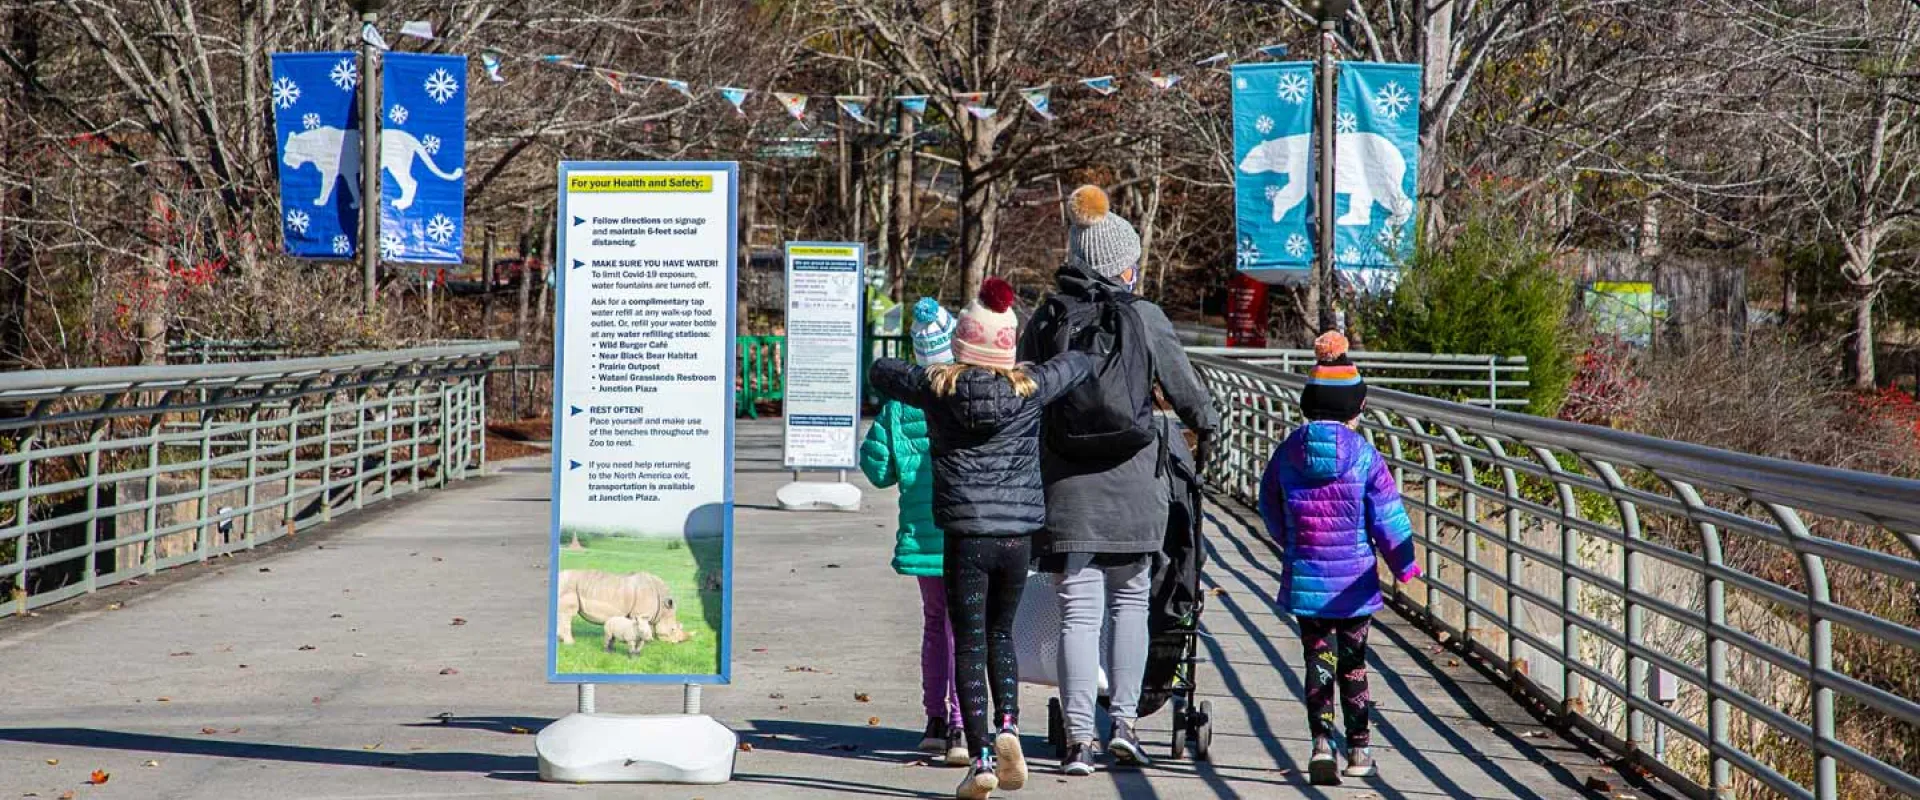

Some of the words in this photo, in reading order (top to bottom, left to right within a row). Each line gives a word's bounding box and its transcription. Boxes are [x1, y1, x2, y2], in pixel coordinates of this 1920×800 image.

[590, 180, 611, 188] your
[670, 179, 703, 188] Safety:
[629, 298, 689, 307] complimentary
[661, 309, 692, 317] walk-up
[612, 417, 643, 426] yourself
[635, 461, 652, 470] help
[654, 461, 690, 470] returning
